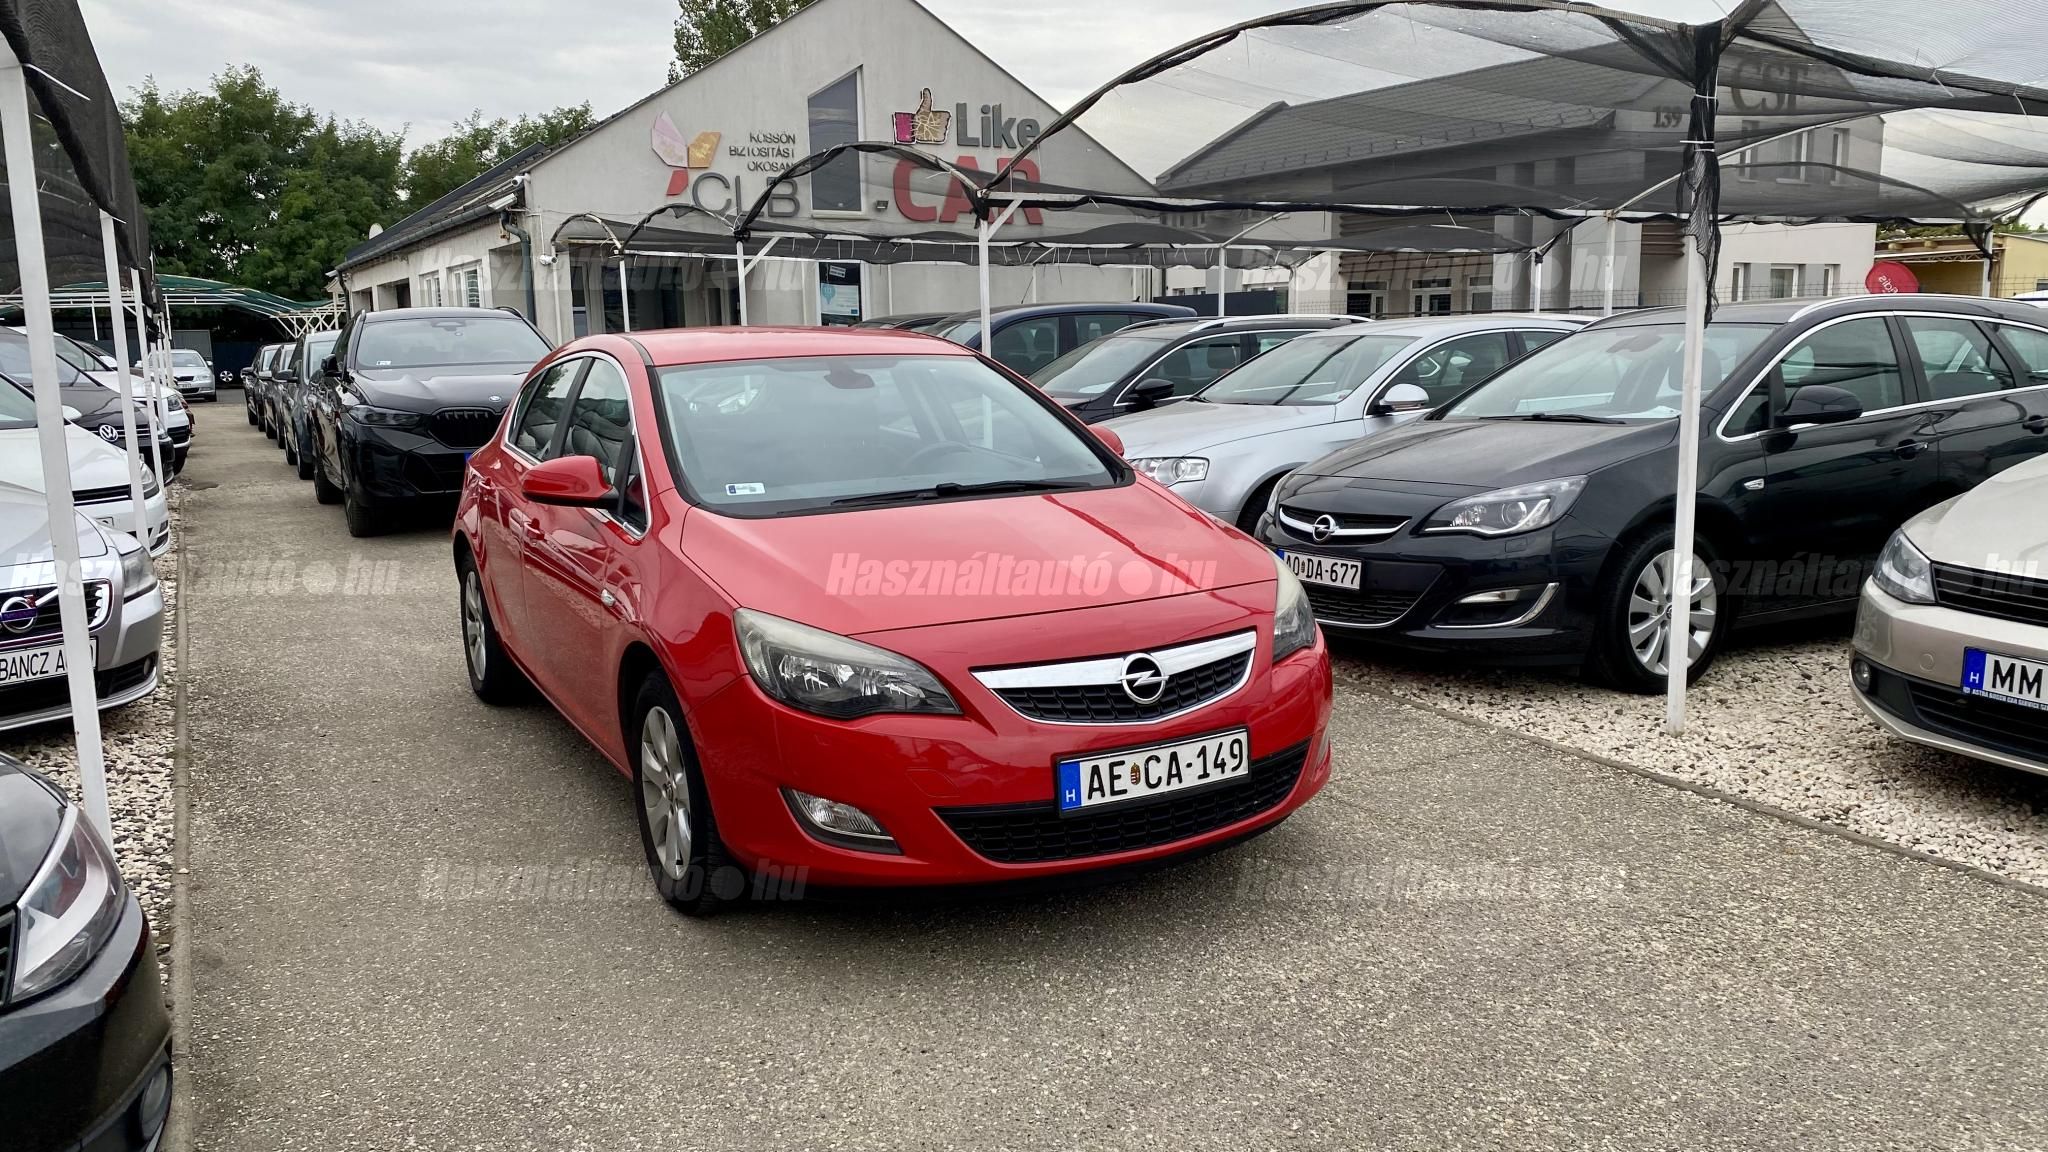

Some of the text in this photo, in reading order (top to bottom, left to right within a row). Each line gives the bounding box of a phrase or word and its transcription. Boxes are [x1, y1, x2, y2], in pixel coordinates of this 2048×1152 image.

[956, 102, 1041, 149] Like
[893, 155, 1044, 225] CAR
[1306, 557, 1359, 585] DA-677
[1969, 672, 1980, 684] H
[1065, 788, 1076, 803] H
